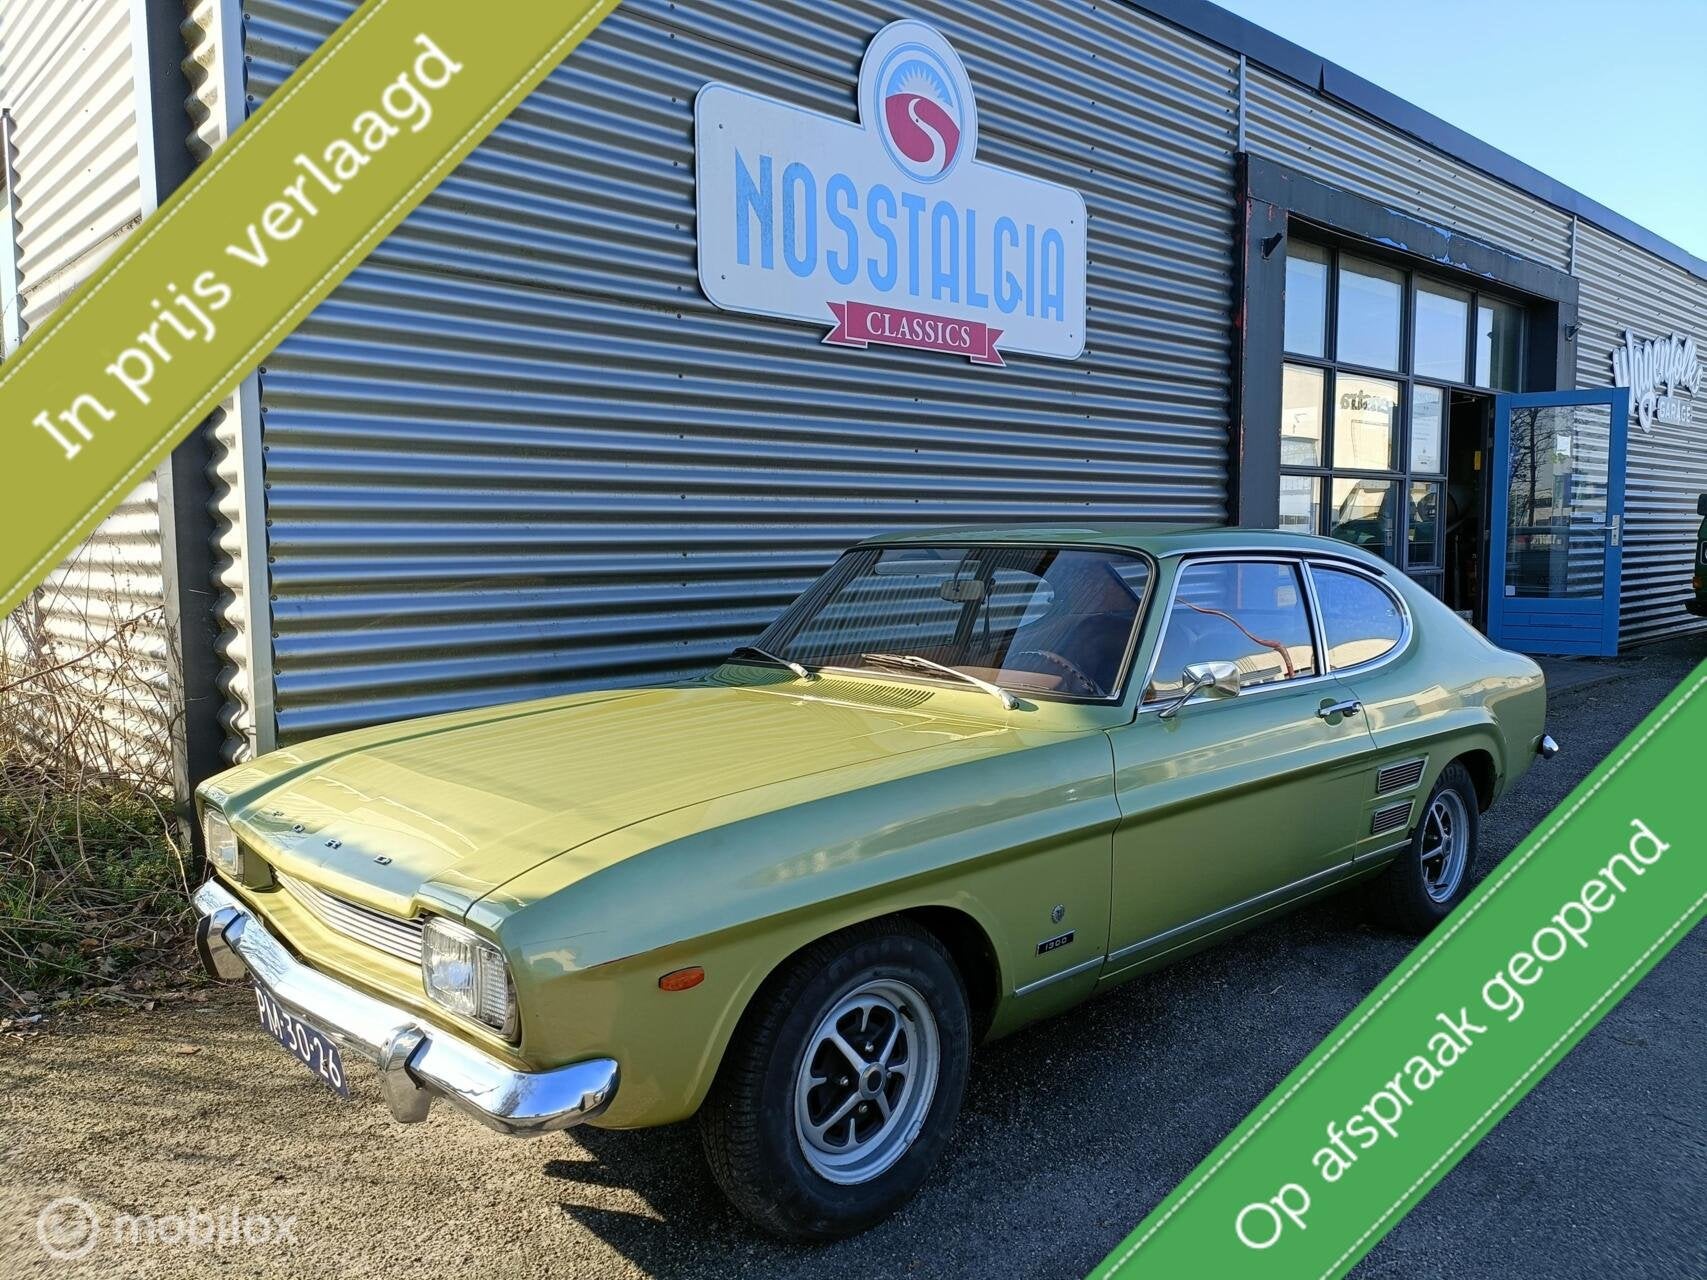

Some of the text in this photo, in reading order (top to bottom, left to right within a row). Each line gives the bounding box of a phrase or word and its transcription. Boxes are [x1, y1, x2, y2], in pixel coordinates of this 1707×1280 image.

[735, 147, 1065, 322] NOSSTALGIA
[866, 311, 971, 348] CLASSICS
[1660, 401, 1692, 424] GARAGE
